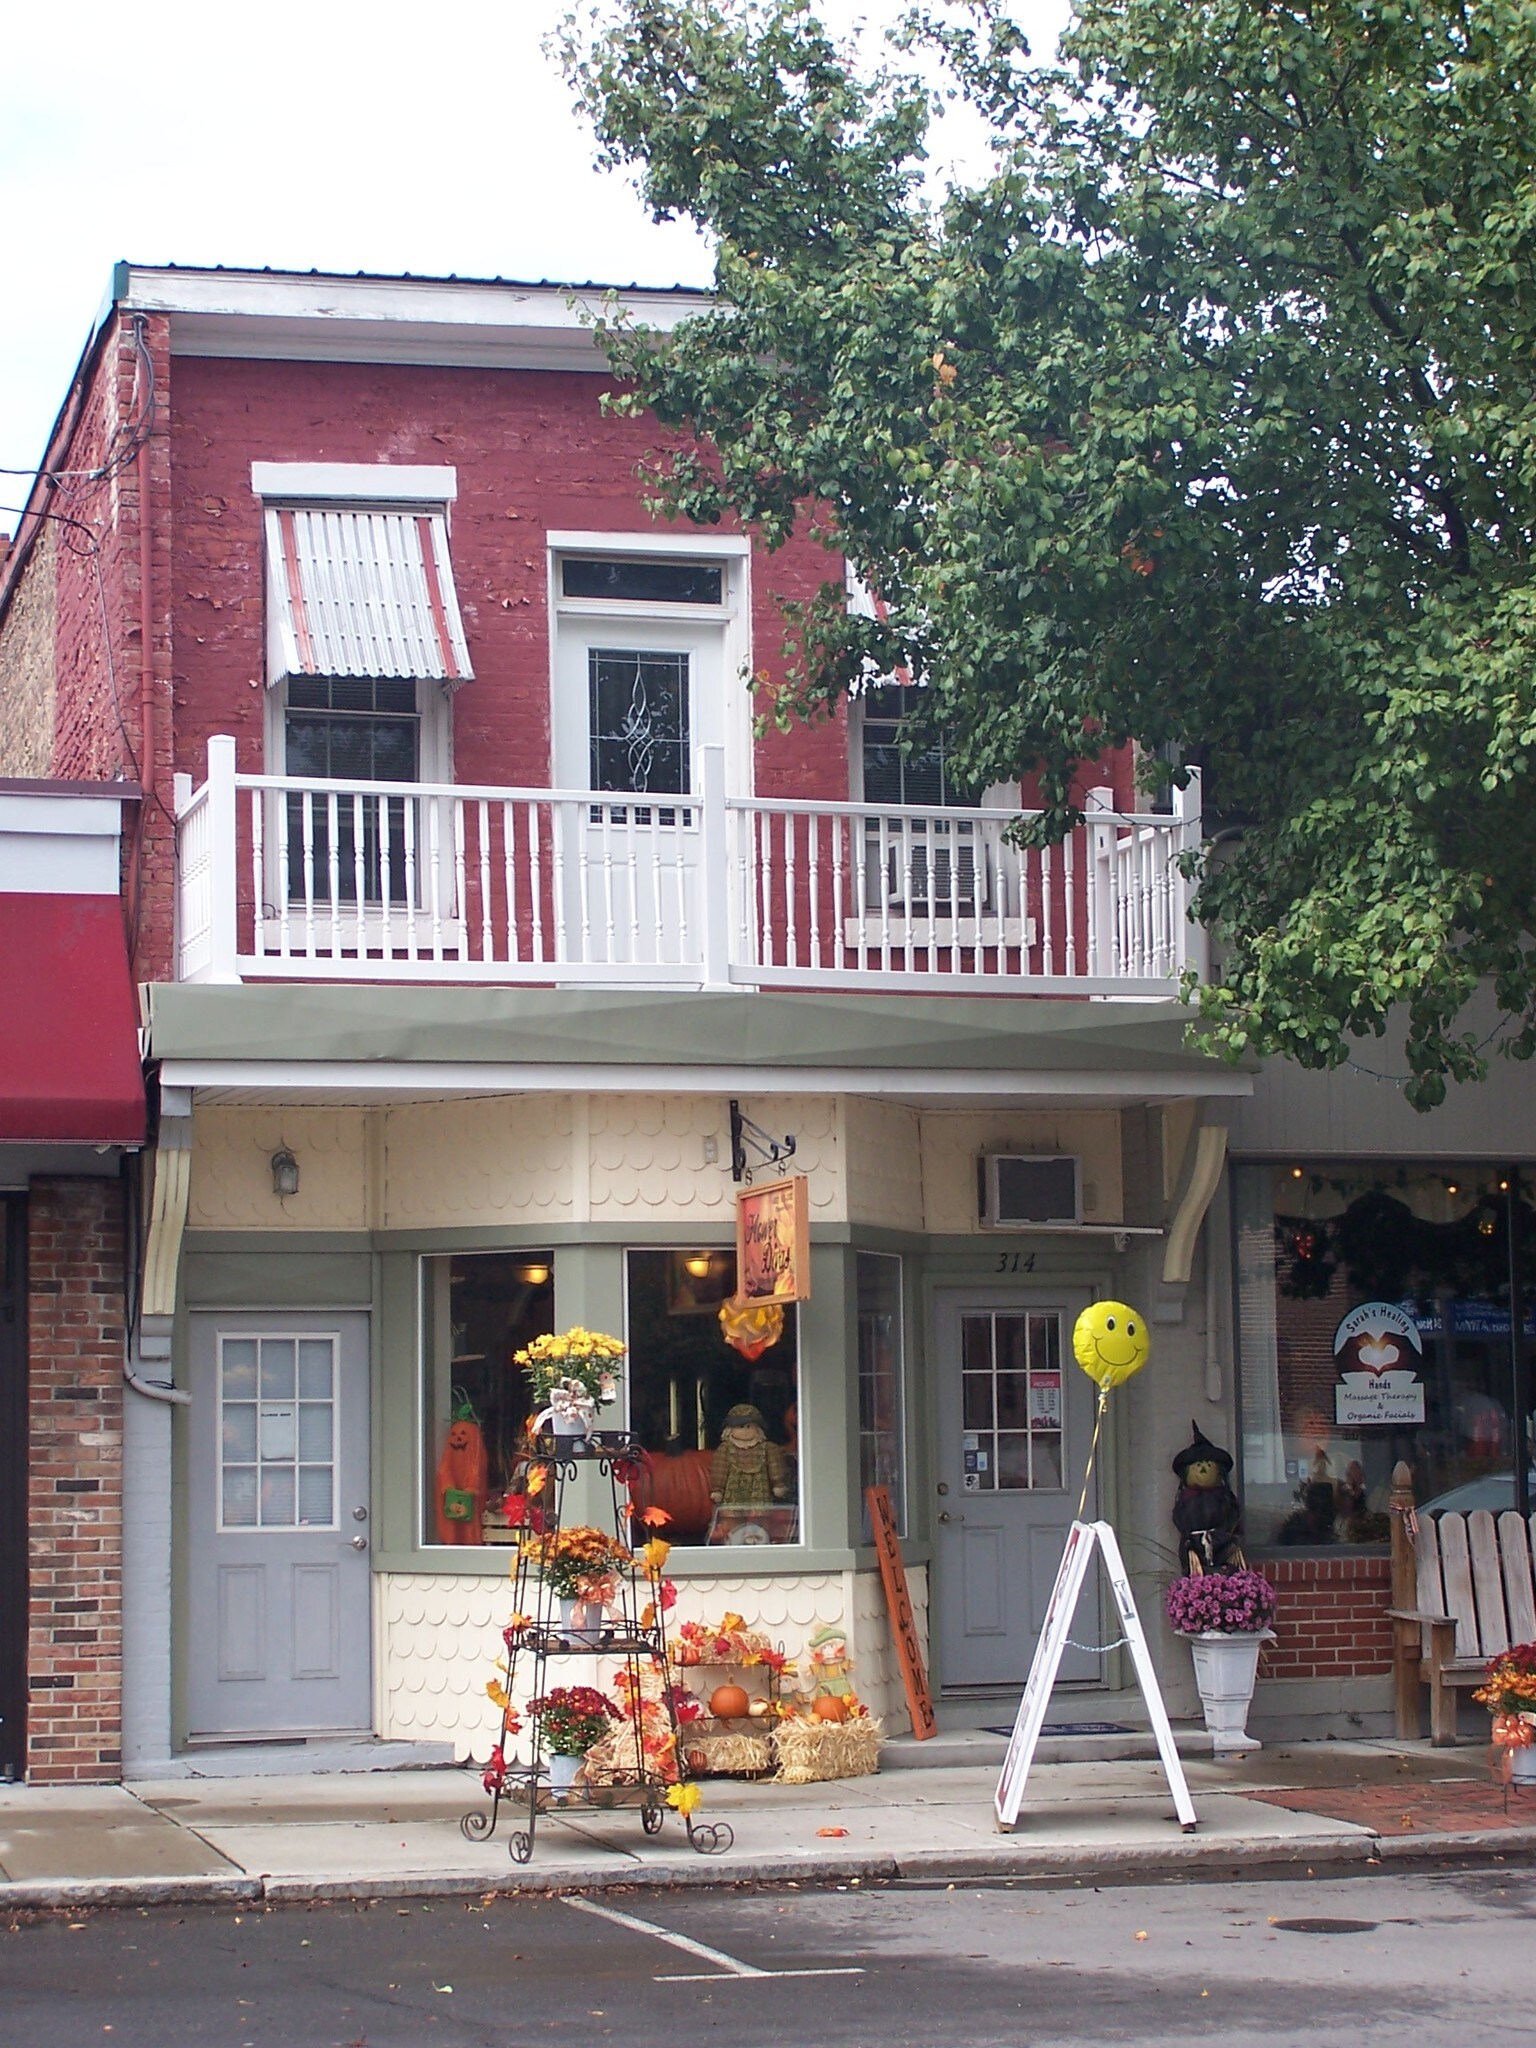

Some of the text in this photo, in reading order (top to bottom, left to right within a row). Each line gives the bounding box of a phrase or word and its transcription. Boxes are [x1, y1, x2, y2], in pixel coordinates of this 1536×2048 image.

[994, 1252, 1036, 1273] 314
[1346, 1306, 1410, 1334] Sarah's Healing
[1369, 1379, 1391, 1390] Hands
[1344, 1392, 1417, 1403] Massage Therapy
[1377, 1402, 1384, 1410] &
[1347, 1411, 1416, 1421] Organic Facials
[876, 1494, 935, 1730] WELCOME
